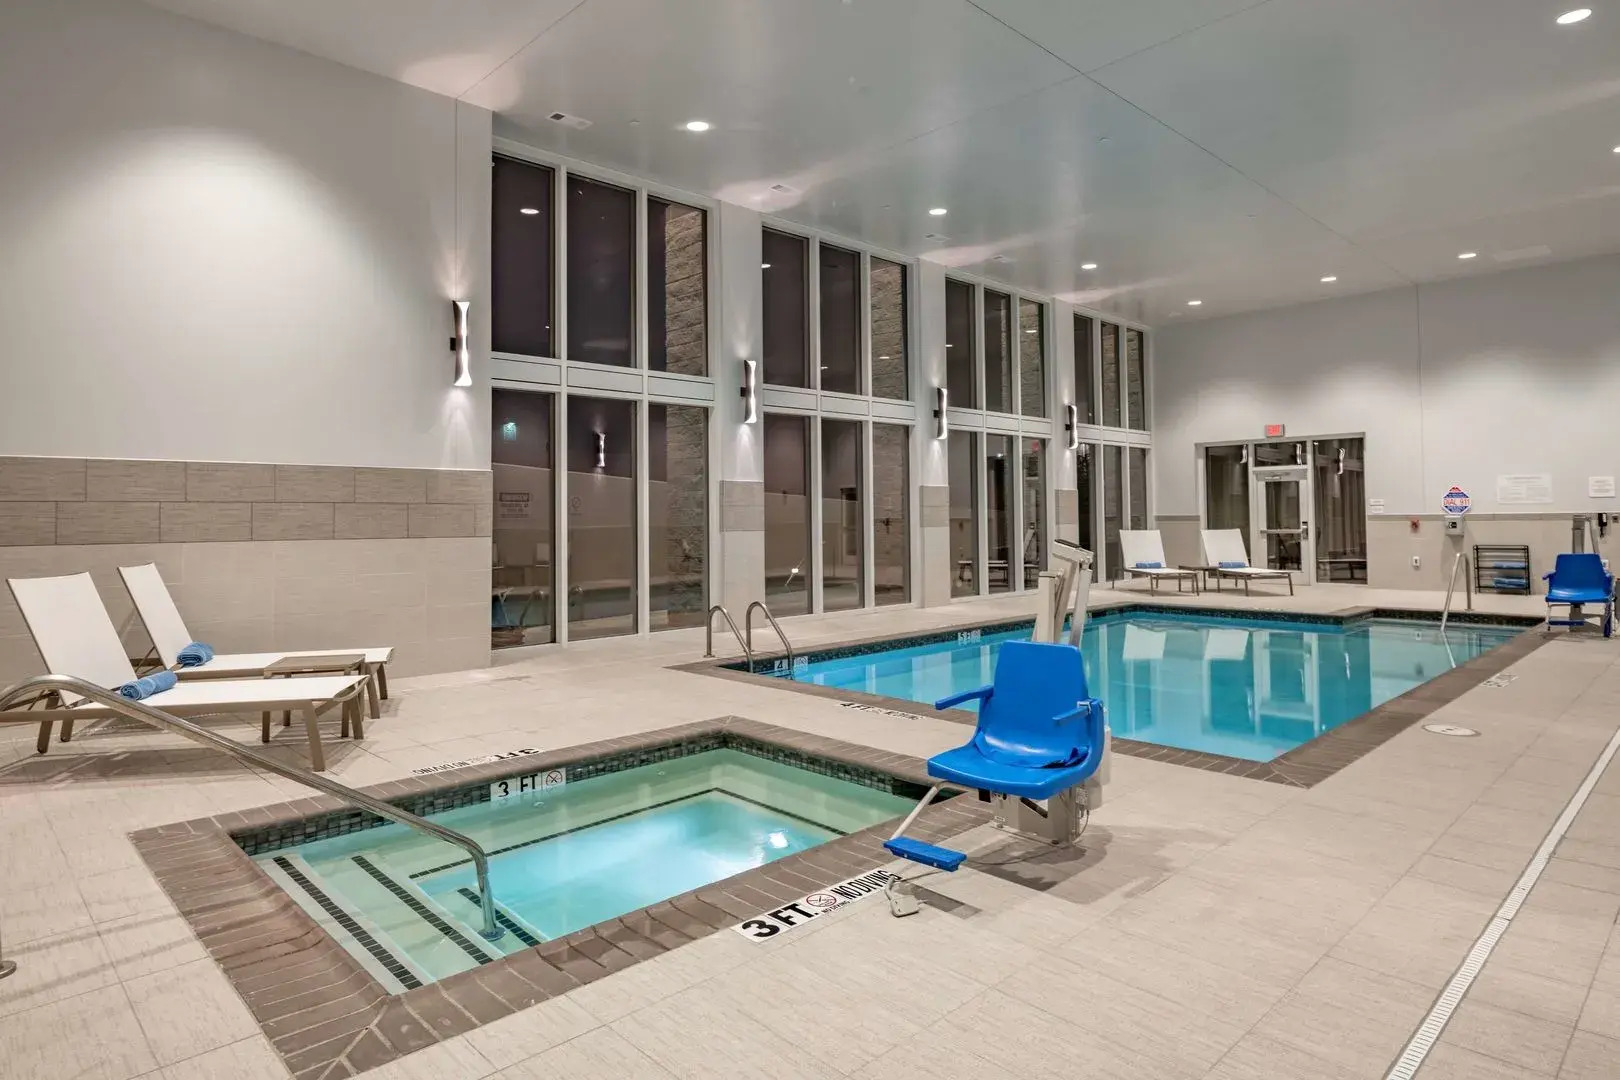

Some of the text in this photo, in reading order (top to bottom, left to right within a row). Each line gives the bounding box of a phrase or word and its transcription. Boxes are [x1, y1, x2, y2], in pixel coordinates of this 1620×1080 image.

[1267, 425, 1281, 435] EXIT
[777, 660, 784, 669] 4
[411, 763, 454, 775] DIVING
[452, 761, 470, 769] NO
[498, 774, 538, 798] 3 FT
[742, 870, 902, 938] 3 FT. NO DIVING
